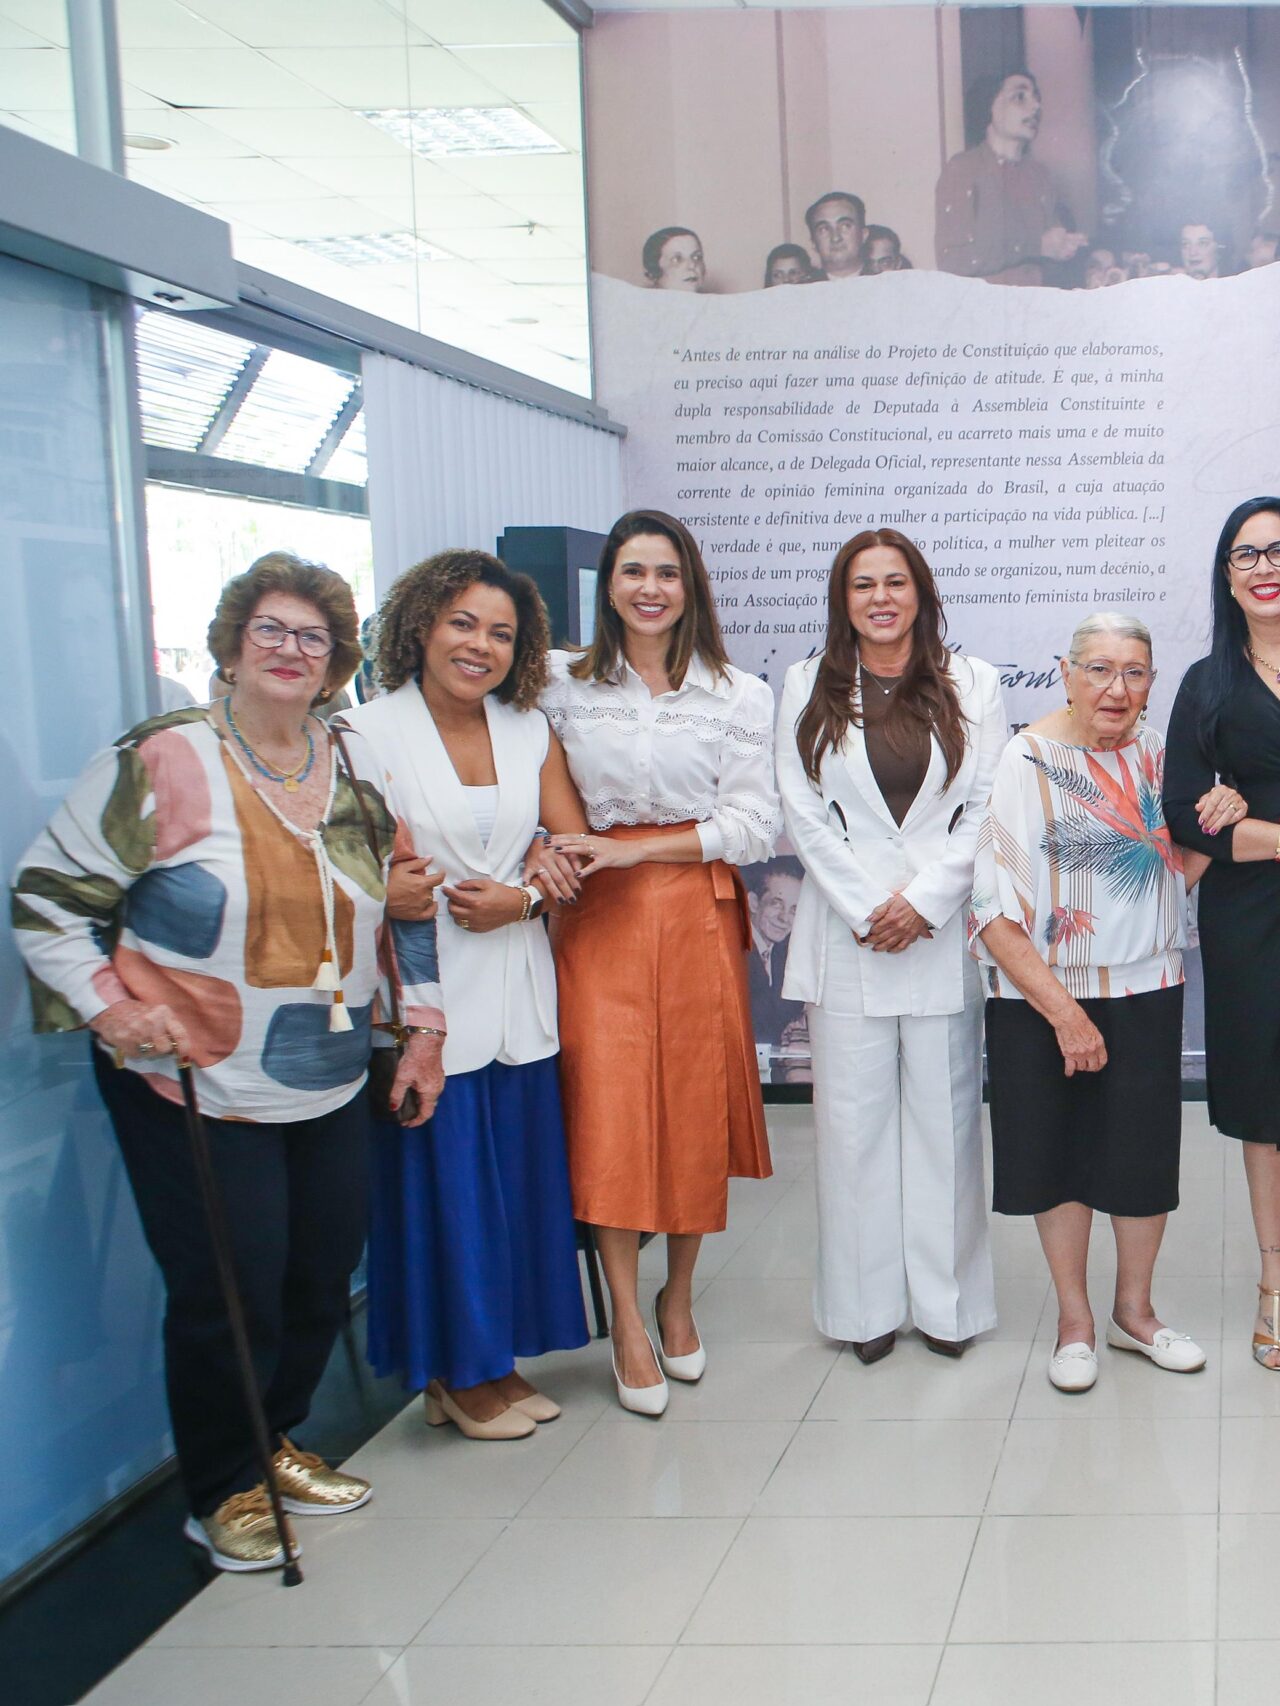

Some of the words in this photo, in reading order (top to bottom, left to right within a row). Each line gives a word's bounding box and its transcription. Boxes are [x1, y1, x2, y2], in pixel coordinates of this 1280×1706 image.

[725, 347, 741, 362] de
[745, 349, 788, 361] entrar
[792, 350, 809, 360] na
[813, 345, 860, 360] análise
[865, 344, 882, 359] do
[887, 344, 937, 362] Projeto
[942, 344, 957, 358] de
[962, 342, 1049, 360] Constituição
[1054, 346, 1077, 359] que
[1082, 341, 1163, 357] elaboramos,
[674, 379, 689, 390] eu
[696, 375, 743, 393] preciso
[749, 374, 778, 392] aqui
[785, 373, 819, 390] fazer
[825, 376, 855, 387] uma
[861, 376, 899, 390] quase
[905, 370, 967, 389] definição
[973, 370, 988, 385] de
[994, 369, 1045, 385] atitude.
[1052, 368, 1064, 384] É
[1070, 373, 1099, 387] que,
[1105, 369, 1113, 383] à
[1120, 368, 1163, 383] minha
[674, 402, 711, 421] dupla
[723, 400, 834, 420] responsabilidade
[845, 400, 860, 415] de
[873, 399, 939, 417] Deputada
[951, 398, 959, 413] à
[971, 397, 1048, 413] Assembleia
[1060, 396, 1146, 411] Constituinte
[1157, 400, 1164, 410] e
[676, 430, 731, 445] membro
[736, 429, 752, 444] da
[757, 429, 824, 443] Comissão
[829, 426, 932, 443] Constitucional,
[937, 430, 953, 441] eu
[958, 428, 1013, 440] acarreto
[1018, 425, 1051, 439] mais
[1057, 428, 1086, 439] uma
[1091, 428, 1099, 438] e
[1103, 424, 1119, 438] de
[1124, 424, 1164, 438] muito
[676, 458, 717, 472] maior
[720, 457, 774, 473] alcance,
[777, 460, 786, 471] a
[790, 456, 805, 470] de
[809, 455, 871, 473] Delegada
[875, 454, 926, 471] Oficial,
[931, 455, 1021, 471] representante
[1026, 456, 1062, 467] nessa
[1067, 451, 1144, 466] Assembleia
[1148, 451, 1164, 465] da
[677, 486, 731, 500] corrente
[740, 484, 756, 498] de
[764, 483, 815, 501] opinião
[824, 482, 885, 499] feminina
[894, 480, 968, 499] organizada
[977, 480, 994, 495] do
[1003, 479, 1049, 496] Brasil,
[1057, 483, 1066, 493] a
[1075, 479, 1103, 496] cuja
[1112, 479, 1165, 496] atuação
[679, 512, 749, 527] persistente
[754, 515, 761, 526] e
[765, 510, 829, 527] definitiva
[833, 509, 863, 524] deve
[867, 514, 875, 524] a
[880, 509, 926, 524] mulher
[930, 512, 939, 523] a
[943, 508, 1027, 526] participação
[1032, 511, 1048, 521] na
[1053, 506, 1081, 521] vida
[1086, 505, 1138, 524] pública.
[710, 538, 761, 554] verdade
[766, 538, 773, 553] é
[778, 542, 806, 556] que,
[932, 535, 988, 553] política,
[993, 539, 1002, 549] a
[1008, 534, 1056, 549] mulher
[1061, 538, 1089, 548] vem
[1095, 533, 1146, 551] pleitear
[1150, 537, 1165, 547] os
[751, 565, 767, 580] de
[770, 569, 792, 580] um
[930, 564, 969, 577] uando
[974, 566, 987, 577] se
[990, 562, 1062, 580] organizou,
[1066, 565, 1096, 575] num
[1100, 561, 1154, 577] decênio,
[1158, 564, 1166, 574] a
[743, 592, 818, 610] Associação
[941, 592, 1020, 605] pensamento
[1025, 589, 1089, 605] feminista
[1093, 587, 1156, 605] brasileiro
[1159, 591, 1166, 601] e
[753, 619, 770, 634] da
[772, 623, 796, 634] sua
